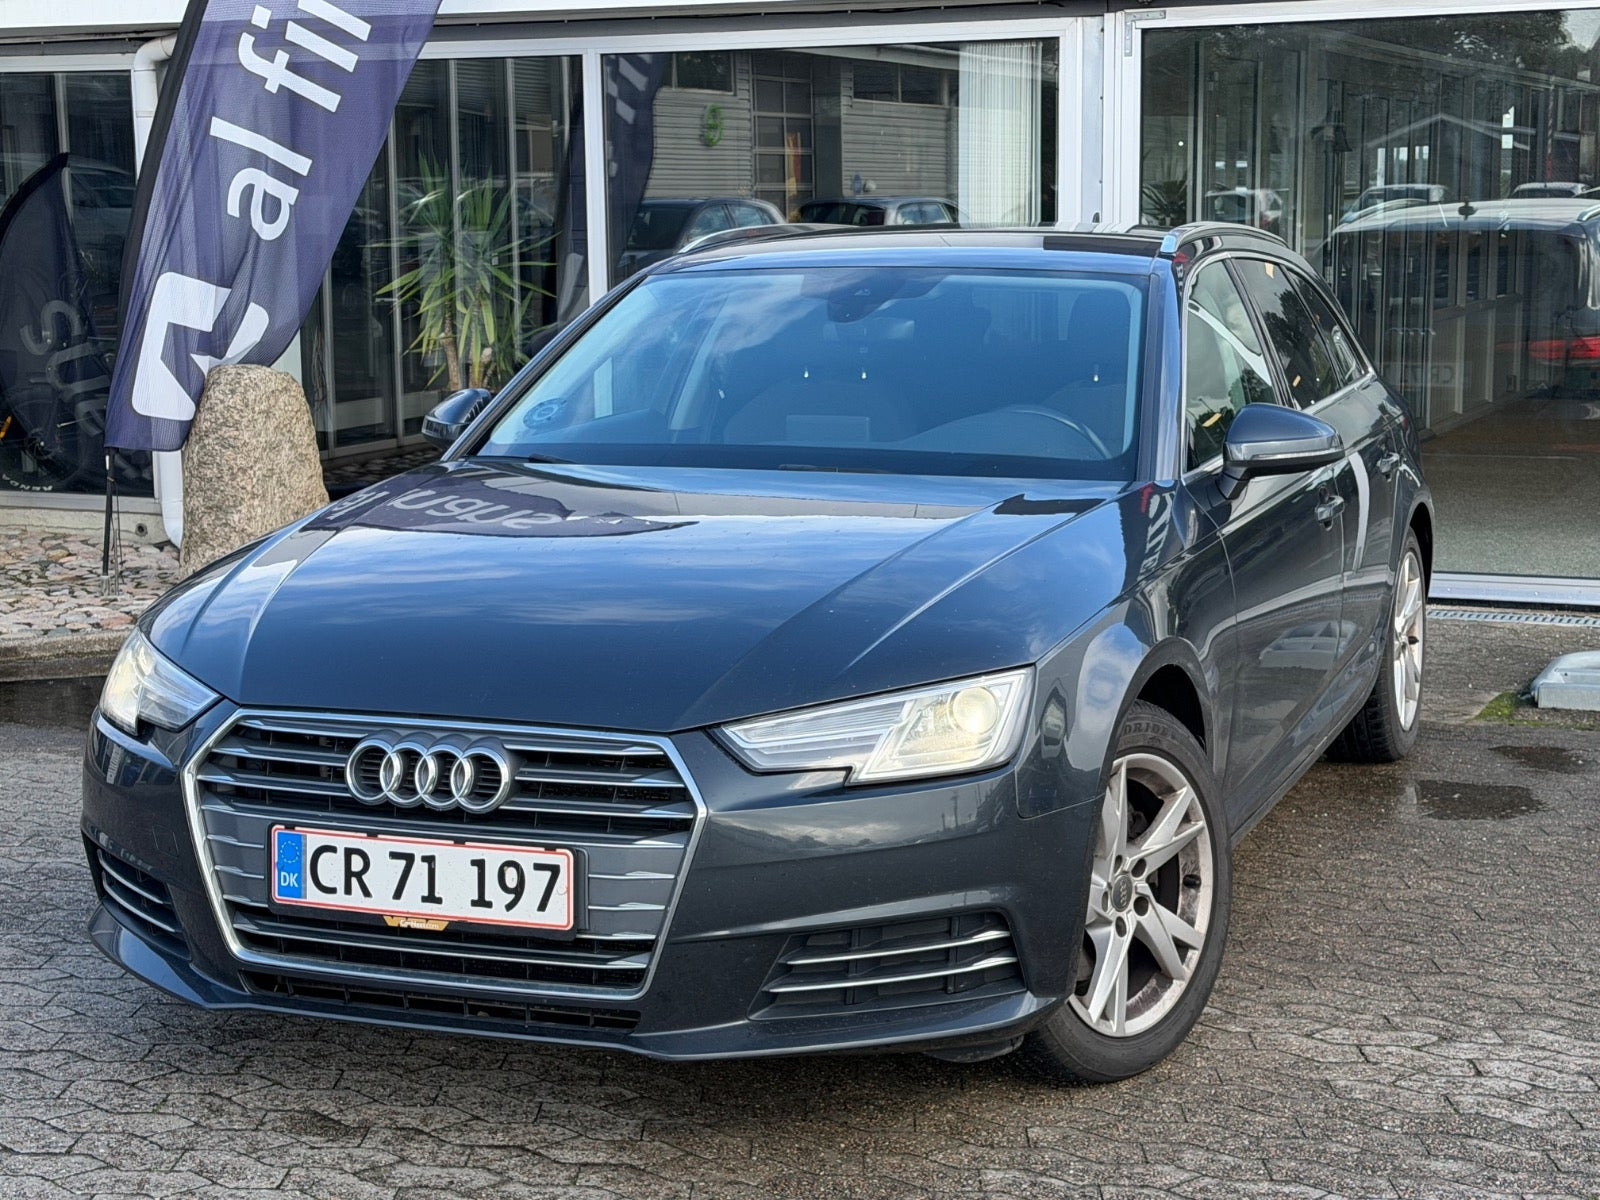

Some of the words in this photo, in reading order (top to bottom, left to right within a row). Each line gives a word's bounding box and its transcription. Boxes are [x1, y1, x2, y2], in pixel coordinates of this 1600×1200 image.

[209, 116, 313, 241] al
[280, 871, 299, 888] DK
[309, 844, 373, 899] CR
[388, 851, 443, 905] 71
[470, 858, 561, 913] 197
